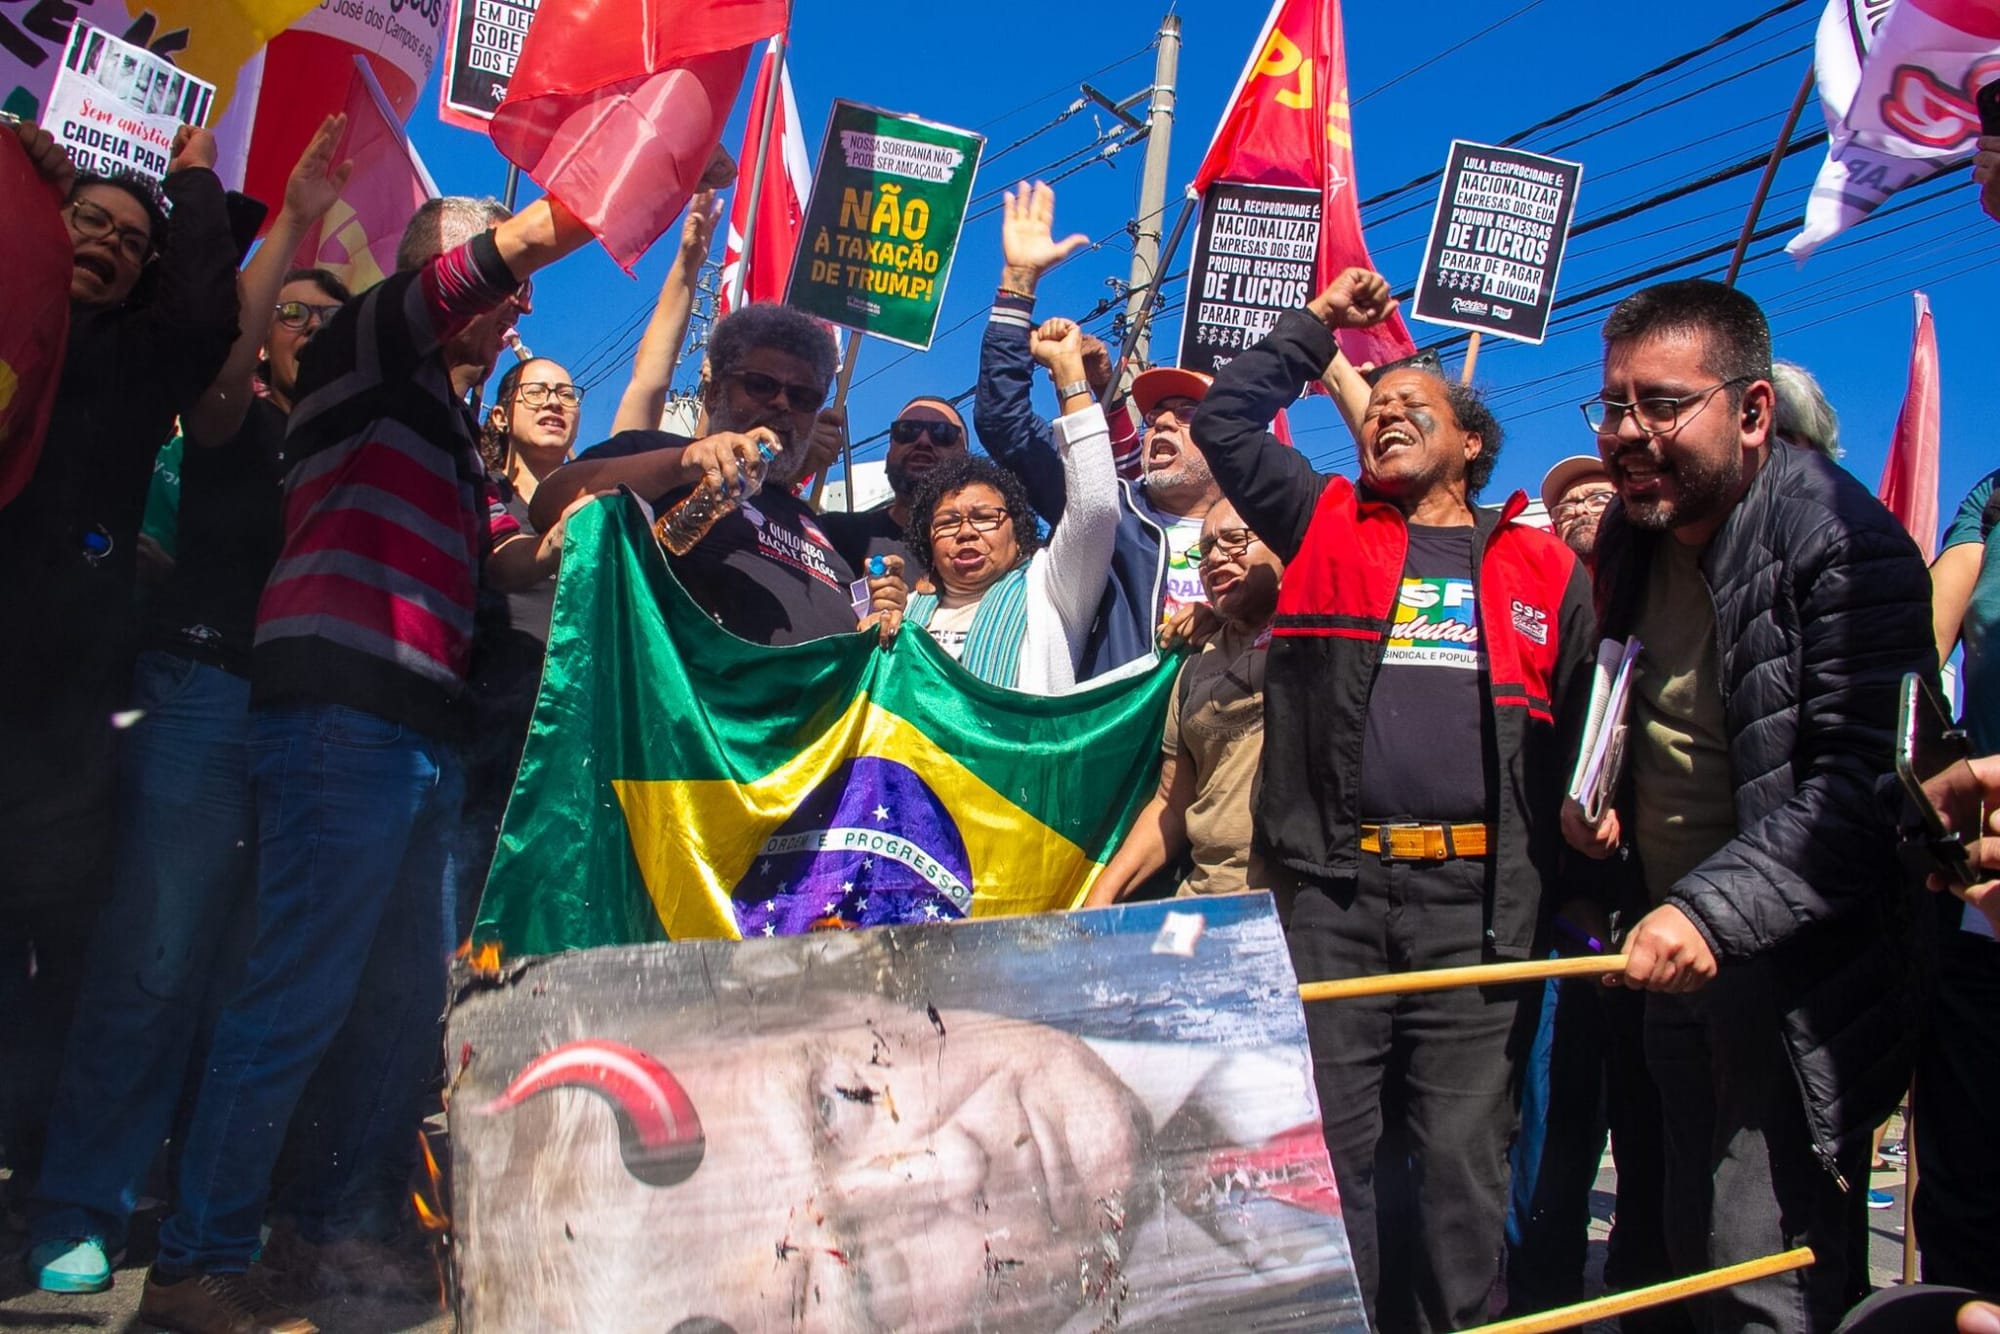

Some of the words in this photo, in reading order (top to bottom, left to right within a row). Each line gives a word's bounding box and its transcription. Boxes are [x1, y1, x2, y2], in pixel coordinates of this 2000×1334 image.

[479, 2, 502, 22] EM
[365, 6, 384, 29] dos
[386, 15, 420, 53] Campos
[476, 23, 525, 53] SOBE
[472, 48, 502, 71] DOS
[80, 98, 113, 124] Sem
[117, 118, 170, 150] anistia
[63, 120, 129, 159] CADEIA
[850, 135, 881, 151] NOSSA
[883, 141, 932, 161] SOBERANIA
[934, 147, 952, 165] NÃO
[852, 153, 875, 167] PODE
[876, 156, 894, 171] SER
[1463, 156, 1487, 173] LULA,
[1489, 160, 1554, 184] RECIPROCIDADE
[1461, 173, 1559, 207] NACIONALIZAR
[839, 183, 930, 241] NÃO
[1217, 197, 1241, 214] LULA,
[1244, 200, 1311, 218] RECIPROCIDADE
[1457, 191, 1510, 211] EMPRESAS
[1513, 202, 1533, 218] DOS
[1535, 206, 1555, 222] EUA
[1215, 215, 1316, 243] NACIONALIZAR
[1451, 207, 1494, 228] PROIBIR
[1495, 214, 1553, 241] REMESSAS
[814, 226, 830, 255] À
[836, 233, 939, 274] TAXAÇÃO
[1212, 236, 1267, 256] EMPRESAS
[1270, 242, 1289, 257] DOS
[1292, 244, 1313, 260] EUA
[1445, 223, 1473, 250] DE
[1475, 227, 1549, 266] LUCROS
[811, 259, 841, 285] DE
[846, 265, 934, 302] TRUMP!
[1207, 256, 1251, 274] PROIBIR
[1253, 260, 1312, 281] REMESSAS
[1442, 252, 1481, 270] PARAR
[1484, 258, 1500, 275] DE
[1502, 263, 1541, 285] PAGAR
[1203, 272, 1230, 300] DE
[1233, 275, 1308, 309] LUCROS
[1484, 279, 1494, 293] A
[1497, 279, 1536, 304] DÍVIDA
[1200, 305, 1239, 325] PARAR
[1243, 311, 1260, 327] DE
[758, 530, 792, 557] RAÇA
[769, 522, 825, 562] QUILOMBO
[1512, 600, 1546, 620] CSP
[1430, 651, 1437, 660] E
[1440, 652, 1485, 664] POPULA
[818, 833, 828, 847] E
[844, 832, 965, 899] PROGRESSO
